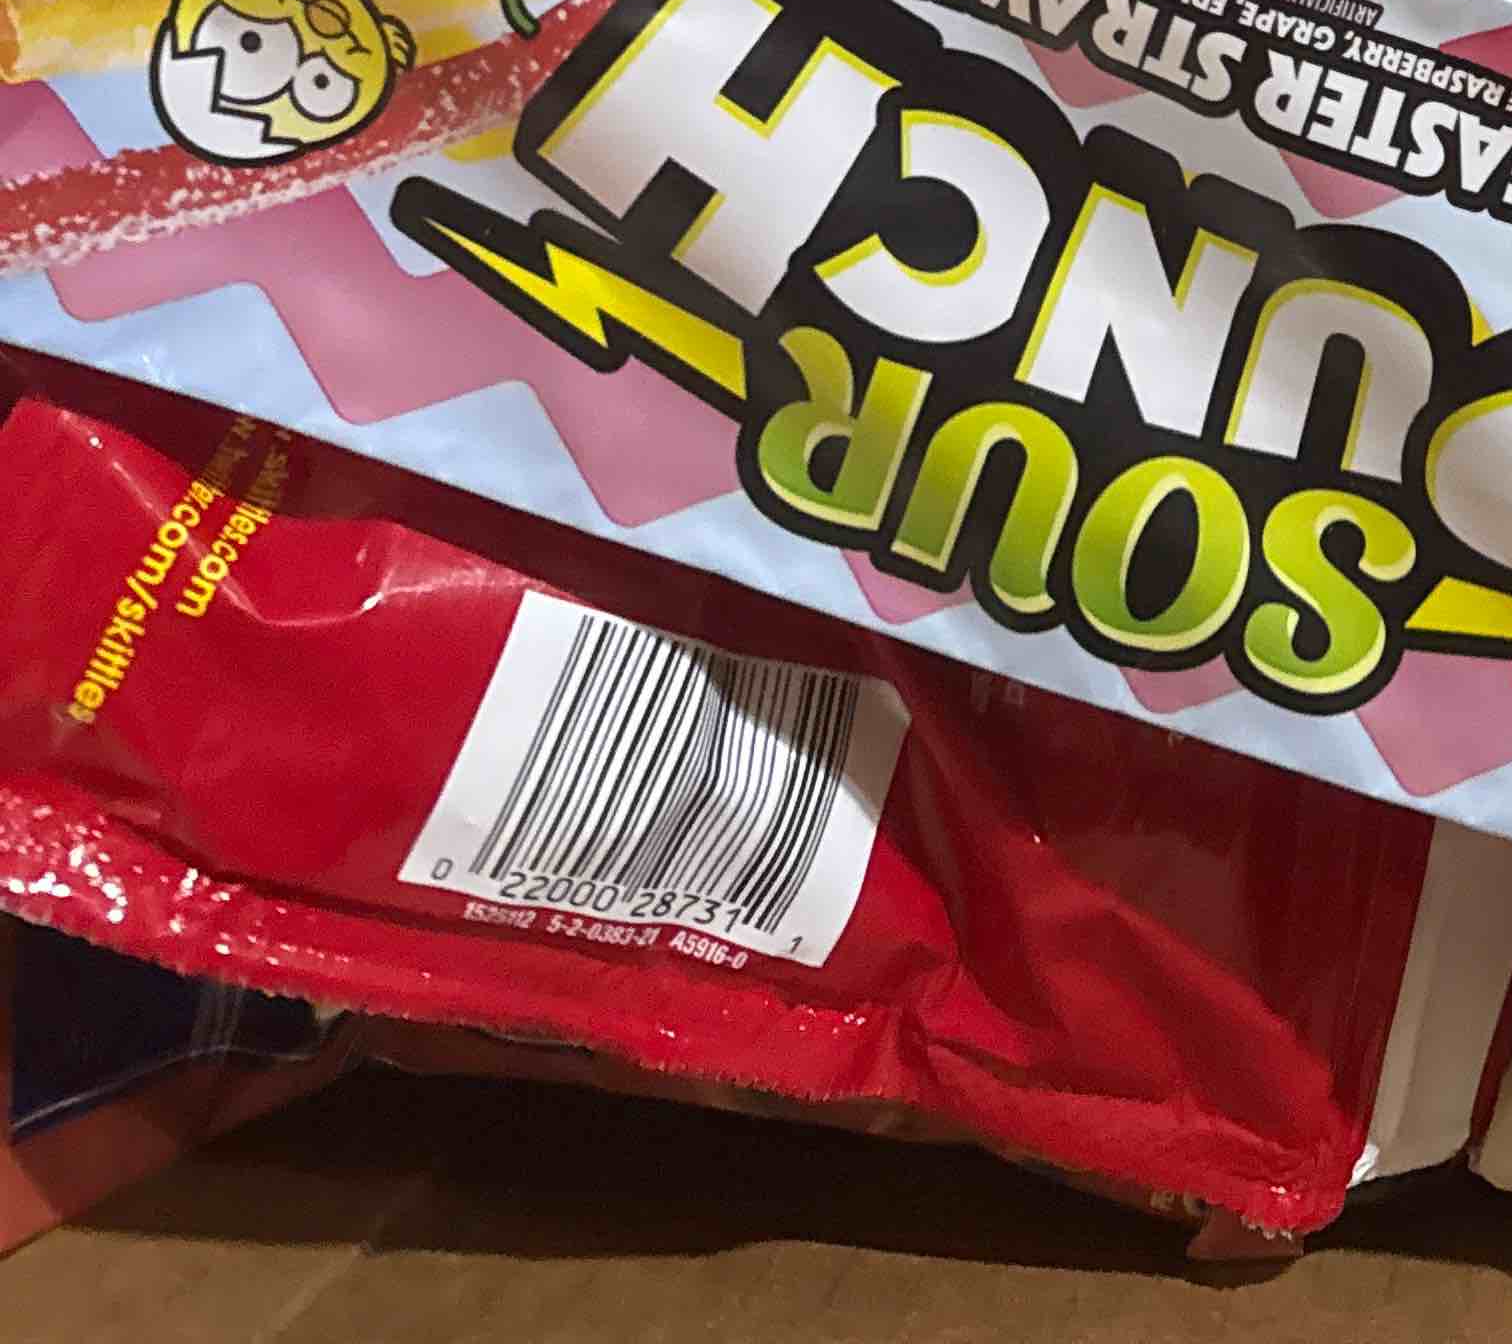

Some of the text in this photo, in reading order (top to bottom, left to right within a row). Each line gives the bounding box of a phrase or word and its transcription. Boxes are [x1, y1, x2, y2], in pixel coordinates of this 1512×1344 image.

[1335, 26, 1508, 108] RASPBERRY,
[758, 326, 1417, 696] SOUR
[430, 859, 804, 955] 0 22000 28731 1
[669, 931, 749, 970] A5916-0
